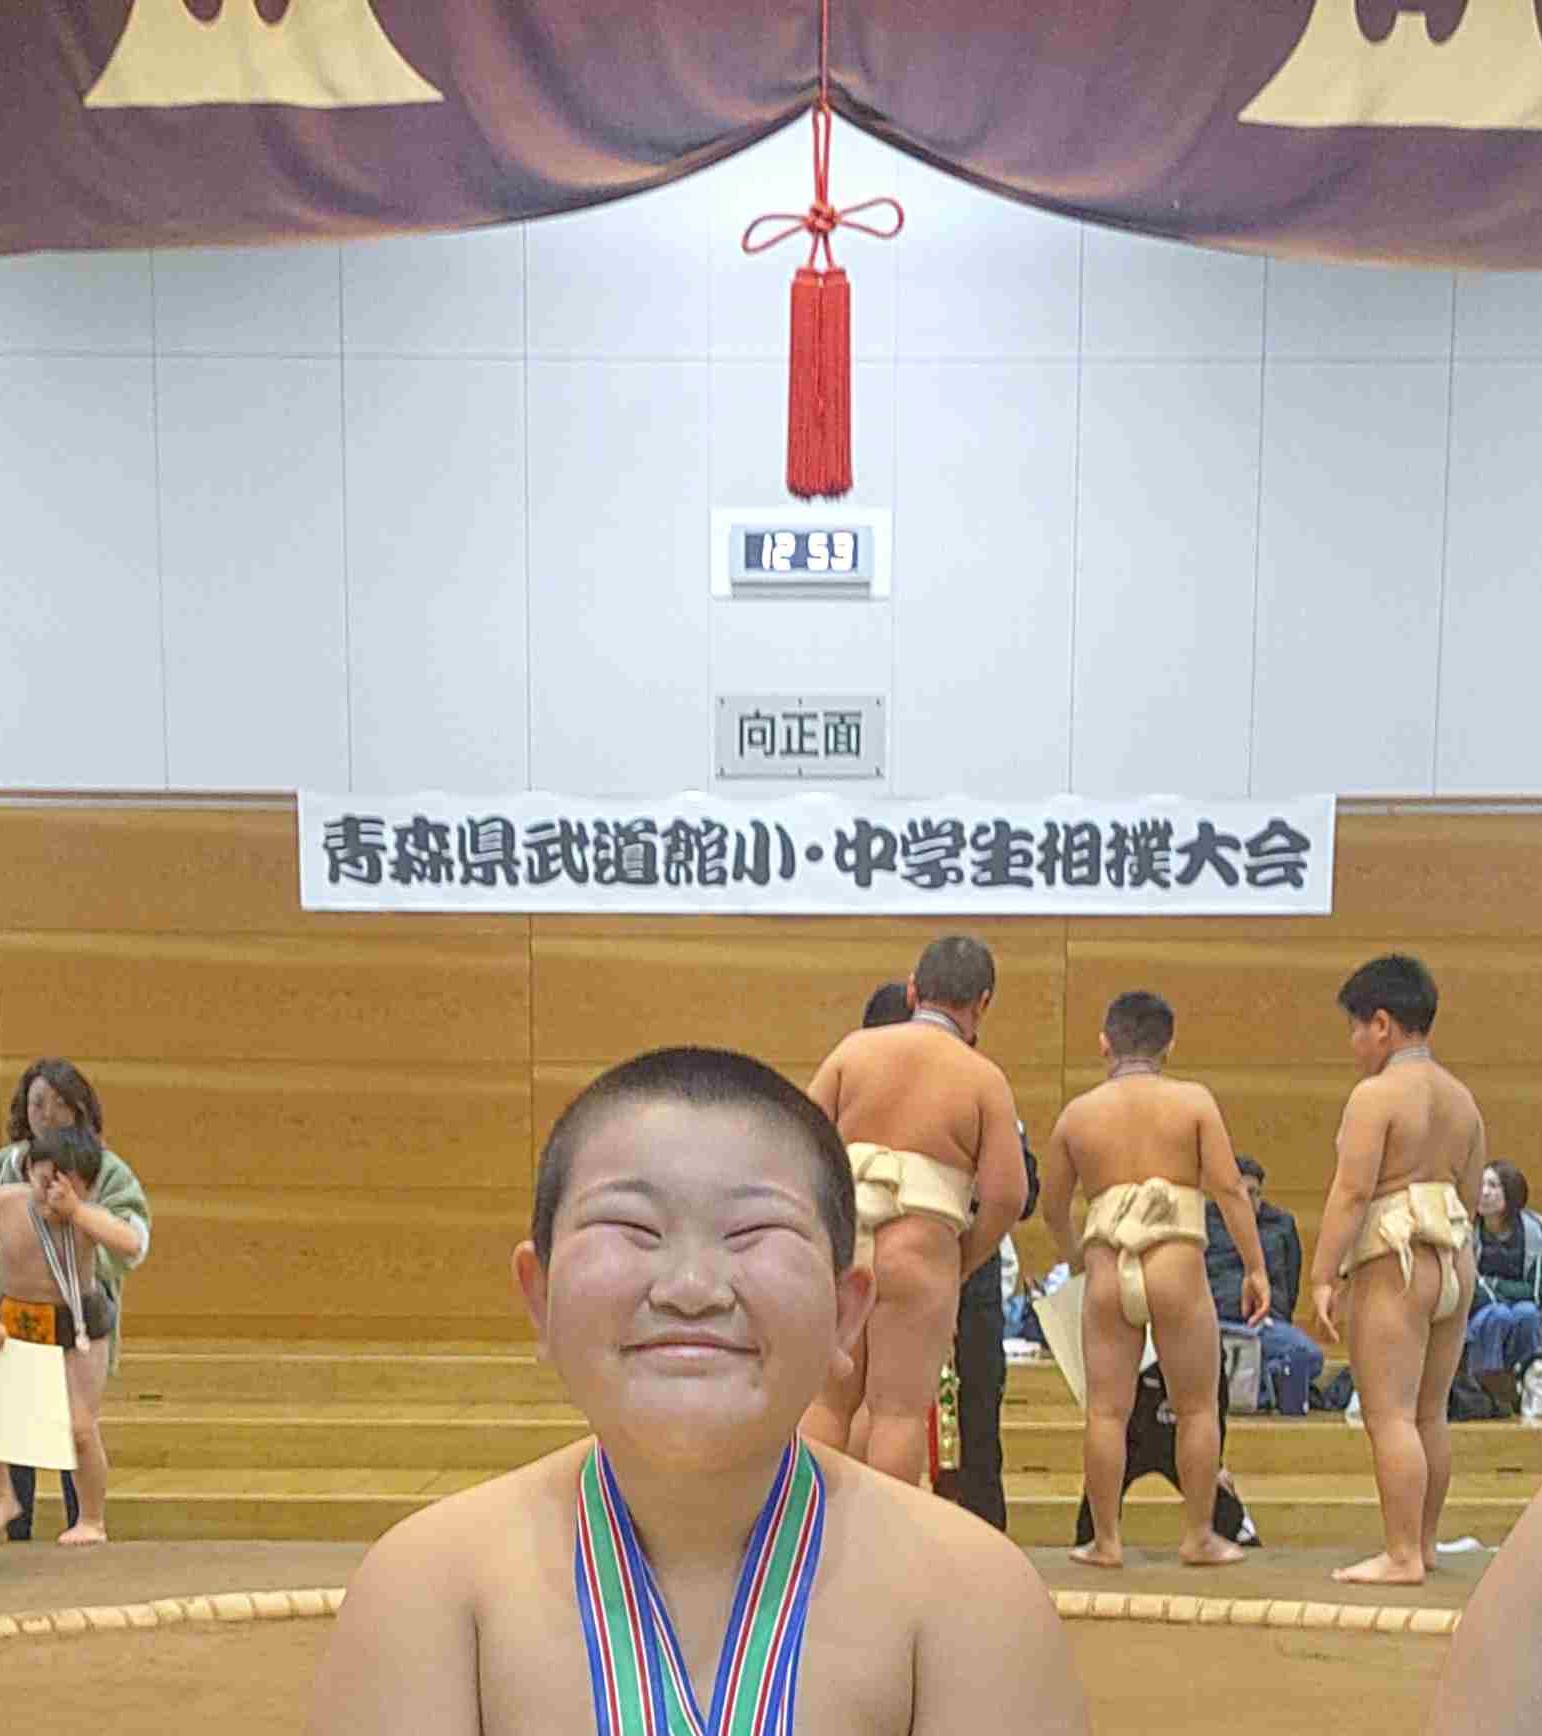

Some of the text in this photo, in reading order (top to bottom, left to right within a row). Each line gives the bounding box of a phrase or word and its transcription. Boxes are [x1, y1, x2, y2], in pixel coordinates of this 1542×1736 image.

[739, 708, 862, 758] 向正面
[322, 816, 1312, 891] 青森県武道館小・中学生相撲大会
